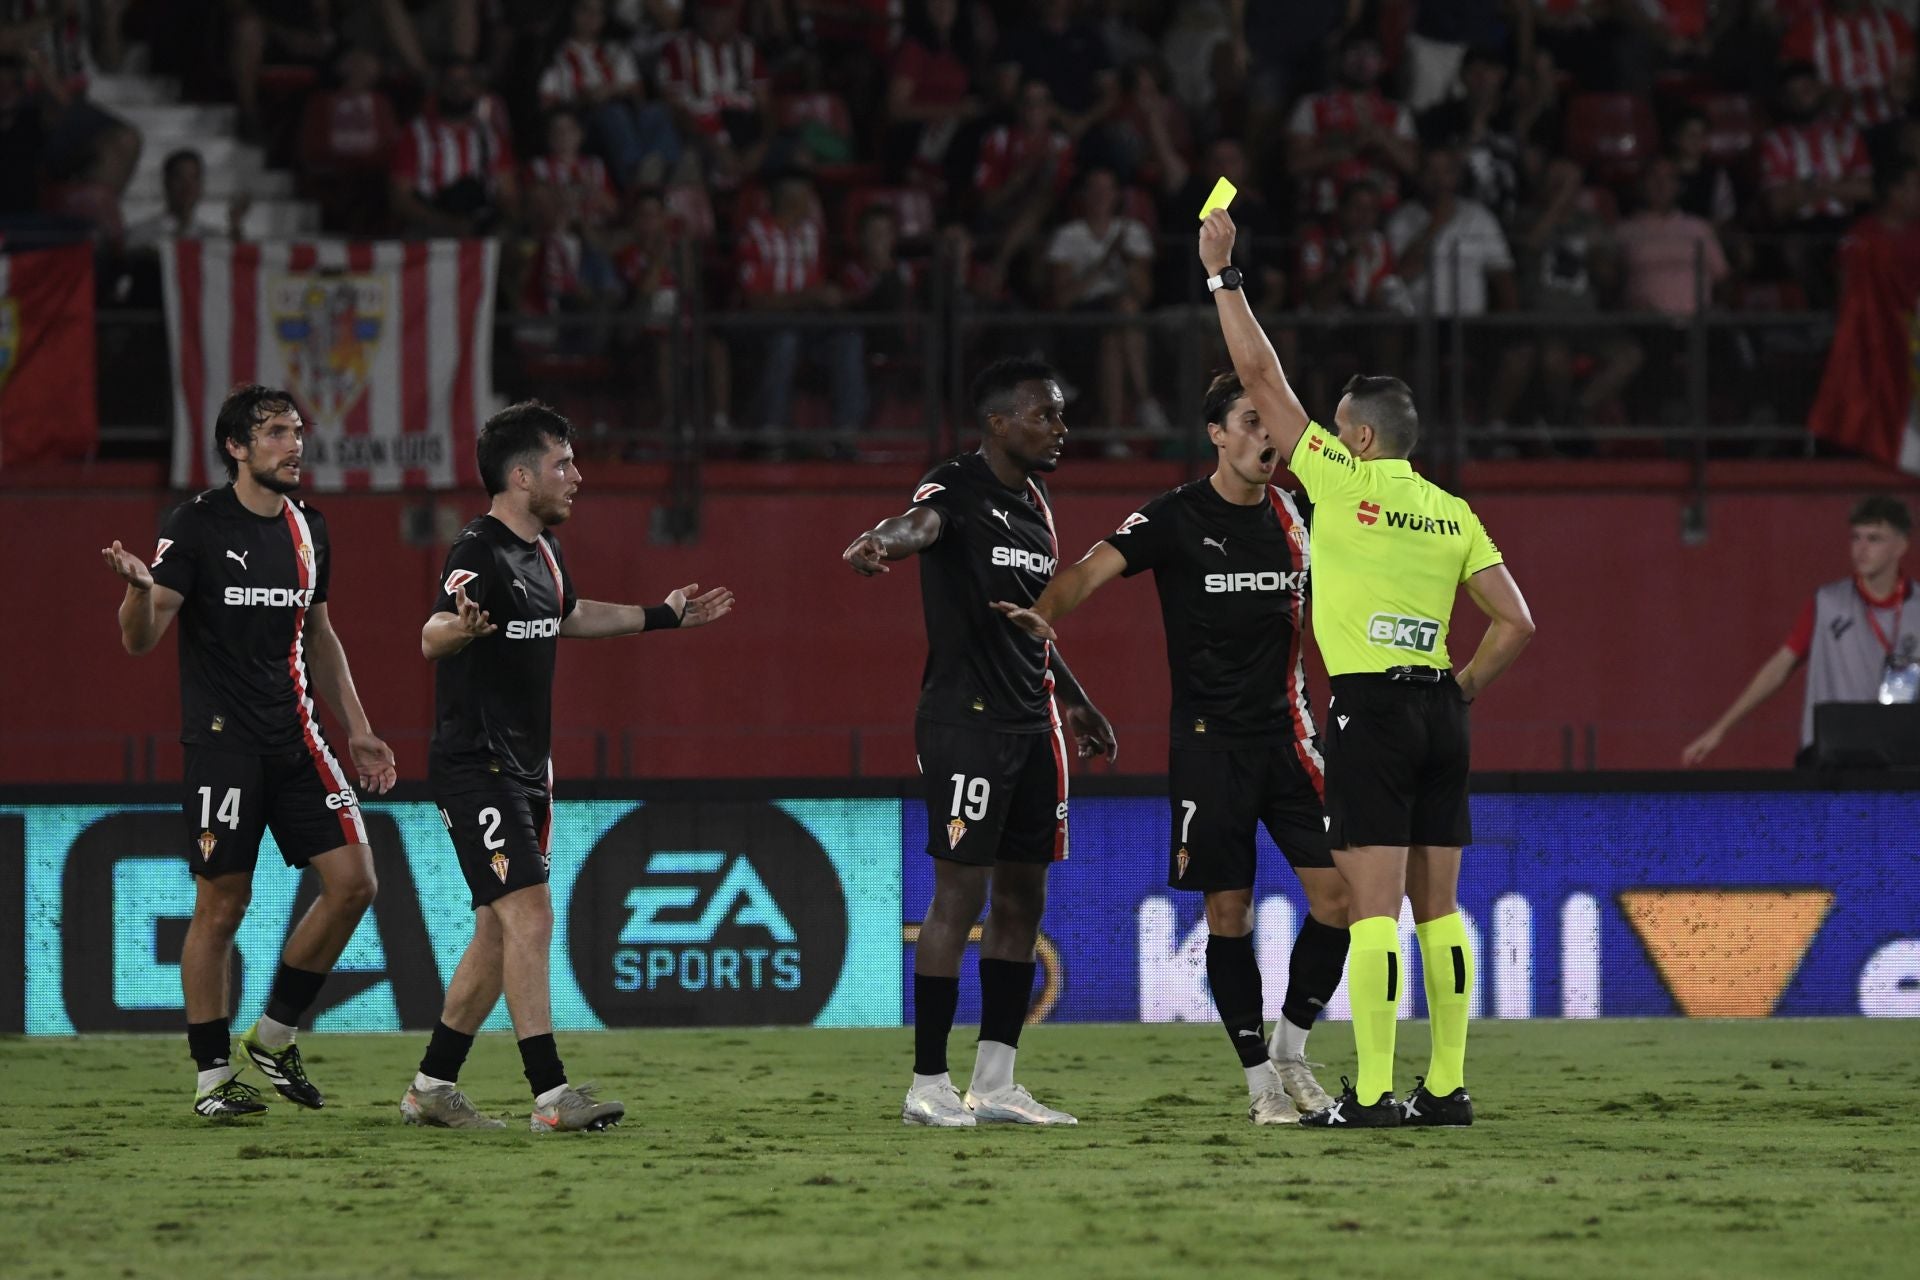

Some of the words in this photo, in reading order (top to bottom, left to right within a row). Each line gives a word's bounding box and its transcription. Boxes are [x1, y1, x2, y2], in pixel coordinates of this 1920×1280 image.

[1385, 511, 1461, 536] WÜRTH
[991, 546, 1058, 577] SIROK
[1370, 618, 1438, 649] BKT
[197, 786, 242, 831] 14
[950, 773, 991, 821] 19
[478, 806, 506, 850] 2
[1181, 799, 1197, 843] 7
[617, 851, 798, 945] EA
[611, 948, 801, 992] SPORTS
